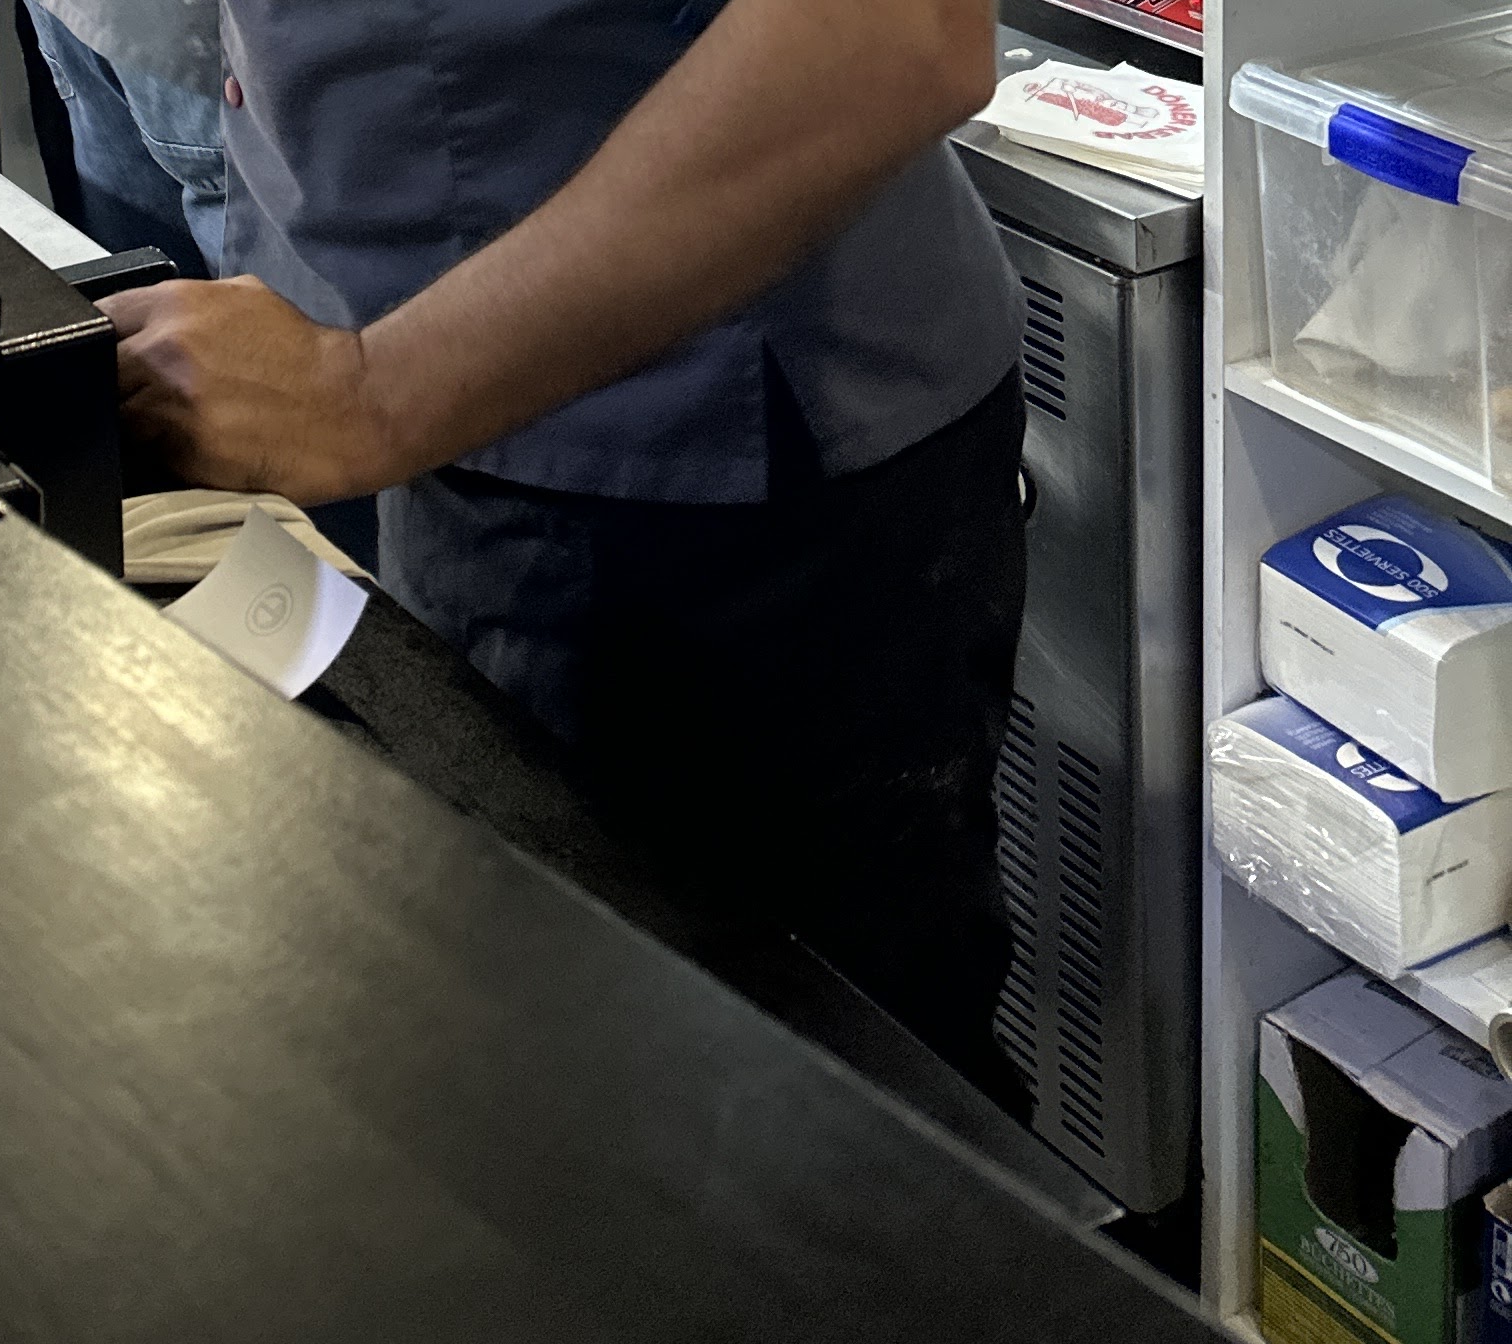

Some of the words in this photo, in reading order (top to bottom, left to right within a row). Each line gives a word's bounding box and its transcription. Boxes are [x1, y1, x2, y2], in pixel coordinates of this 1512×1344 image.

[1141, 85, 1197, 126] DÖNER
[1323, 528, 1410, 581] SERVIETTES
[1407, 578, 1439, 599] 500
